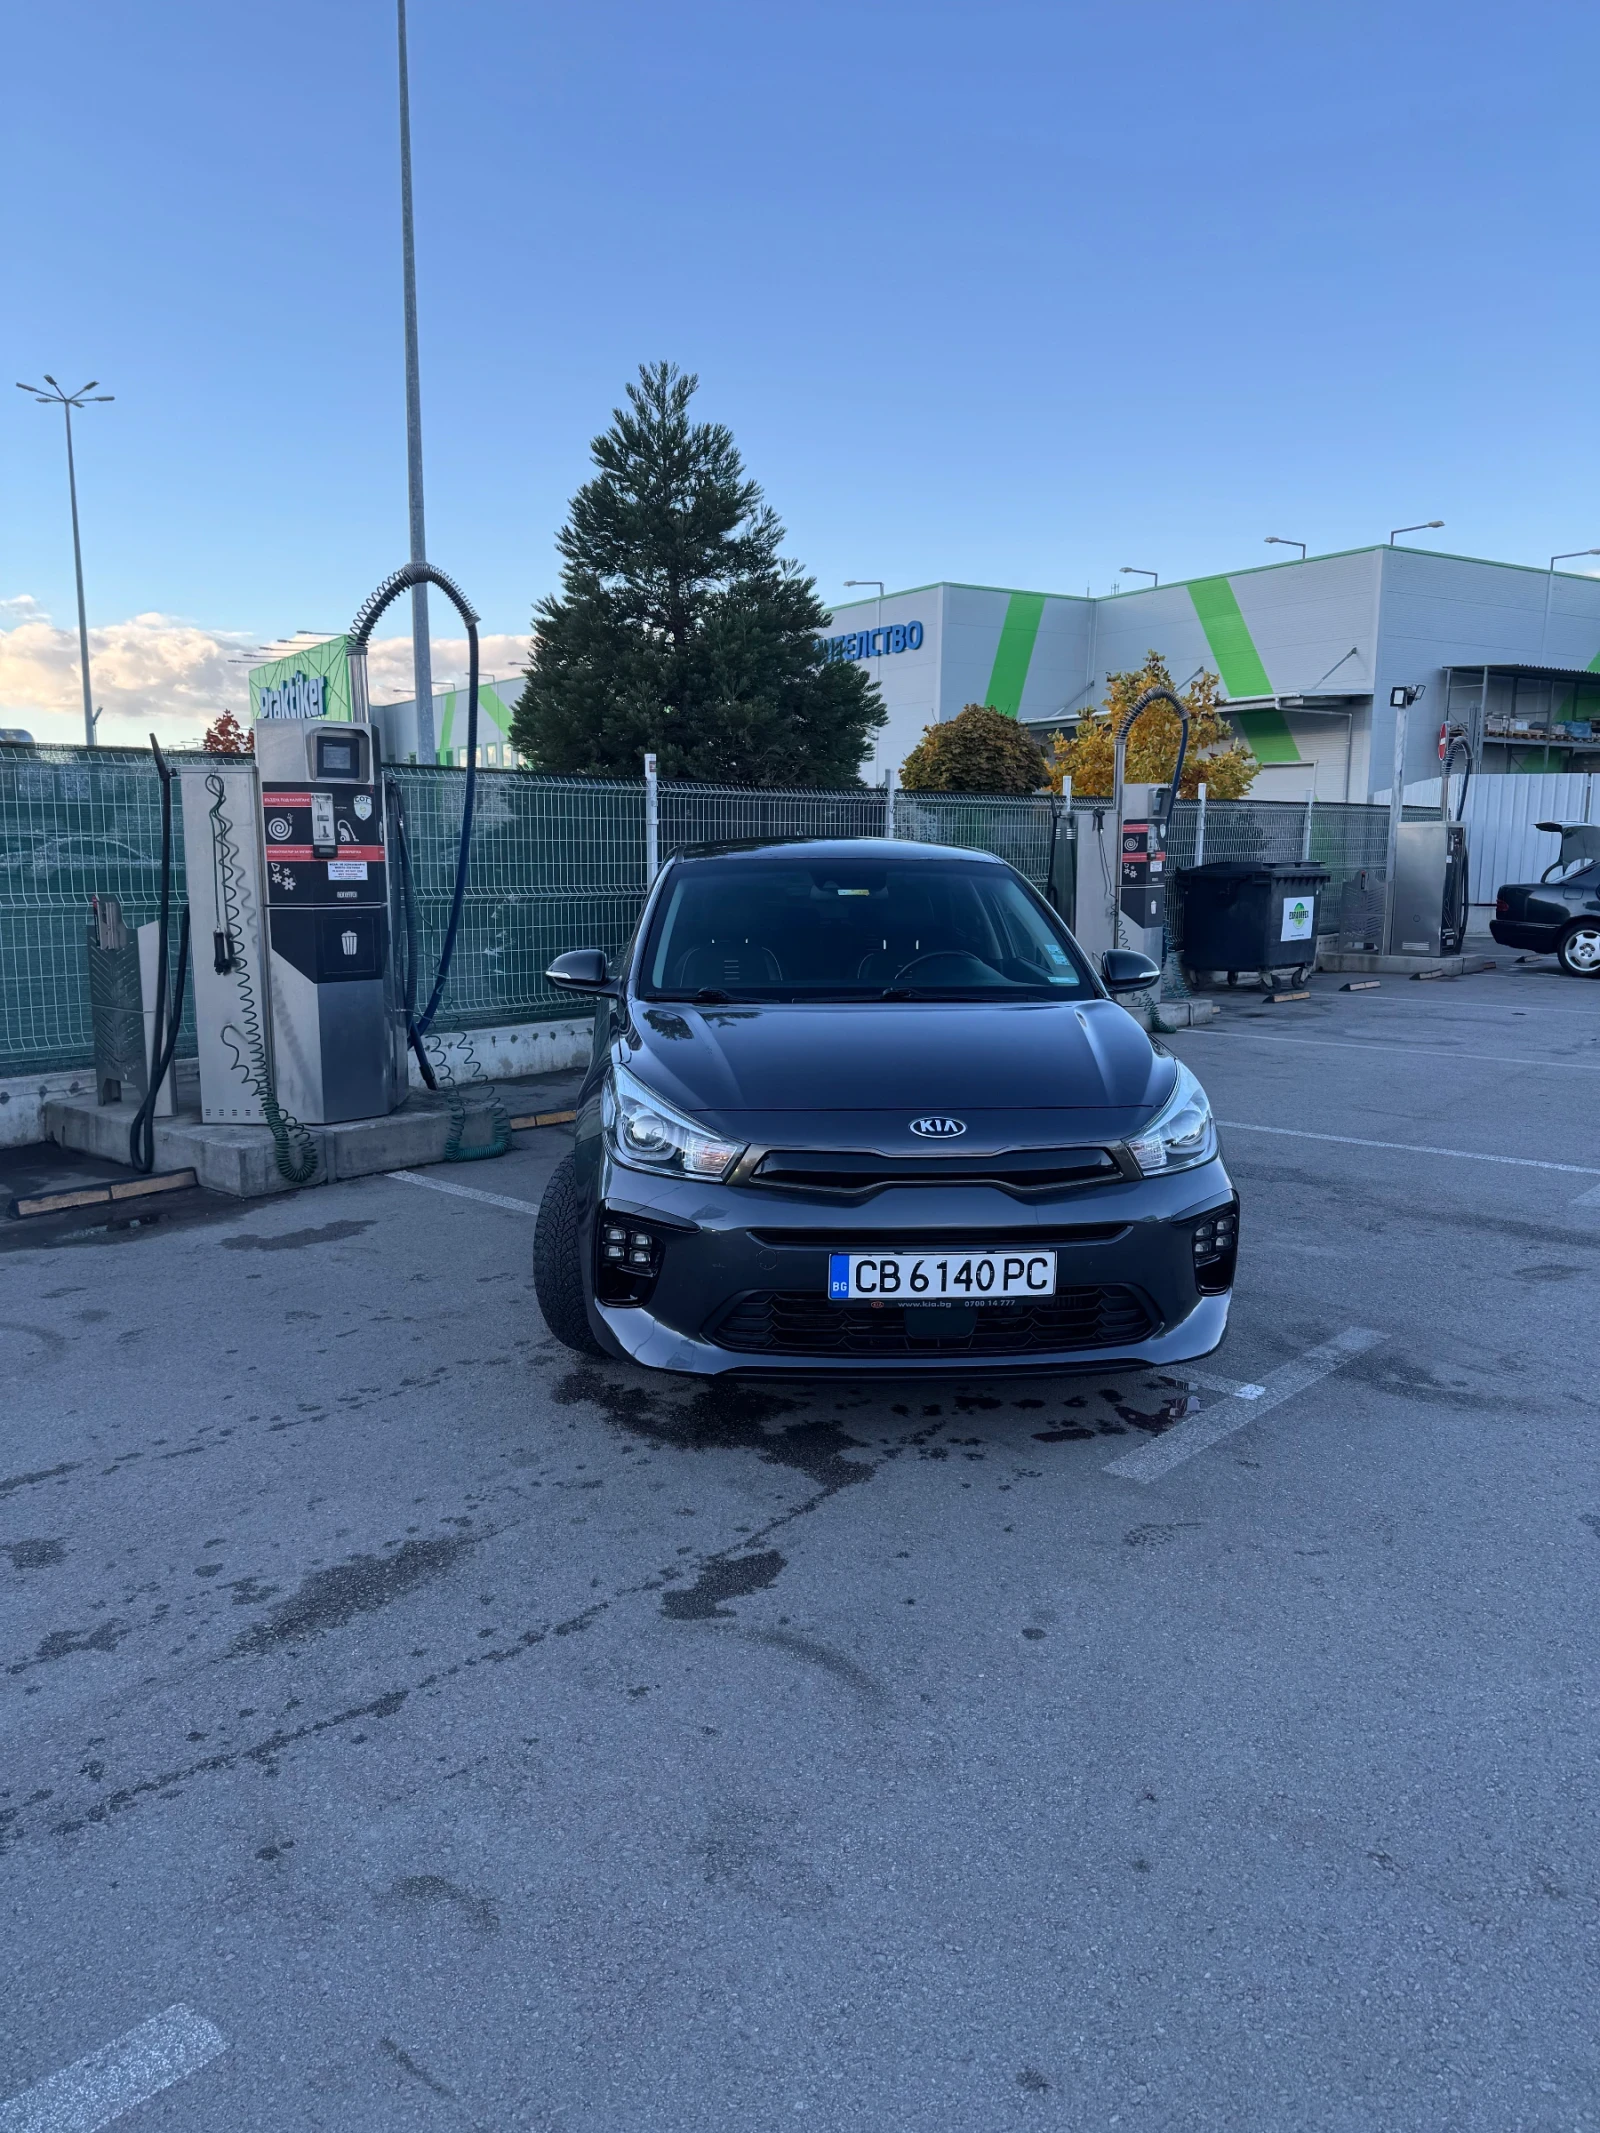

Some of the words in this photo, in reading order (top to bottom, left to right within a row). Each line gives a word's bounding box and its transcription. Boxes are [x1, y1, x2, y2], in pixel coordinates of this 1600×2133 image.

[260, 670, 327, 719] Praktiker
[920, 1119, 958, 1132] KIA
[855, 1259, 900, 1293] CB
[909, 1258, 995, 1293] 6140
[1003, 1257, 1048, 1291] PC
[832, 1281, 847, 1292] BG
[898, 1301, 952, 1309] www.kia.bg
